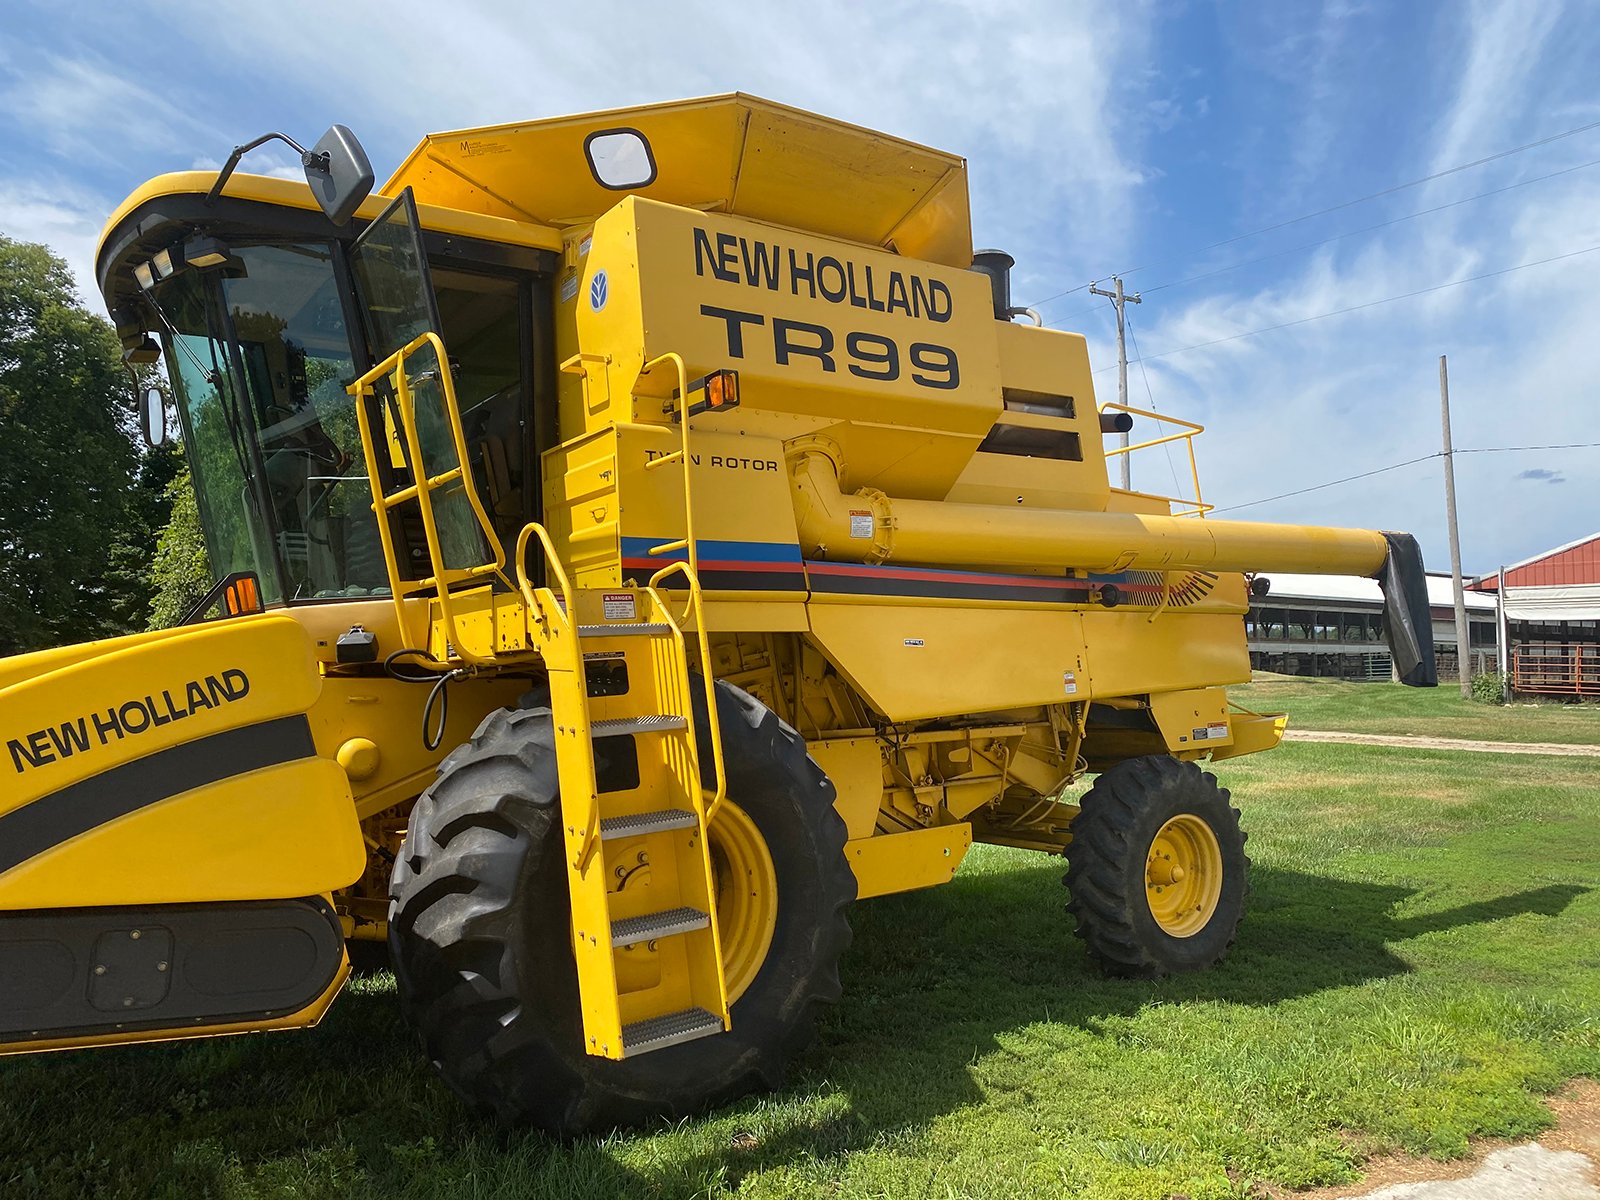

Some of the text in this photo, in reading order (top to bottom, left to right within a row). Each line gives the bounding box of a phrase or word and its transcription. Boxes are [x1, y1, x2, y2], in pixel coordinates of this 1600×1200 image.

[693, 227, 952, 323] NEW HOLLAND
[700, 304, 960, 389] TR99
[711, 456, 778, 472] ROTOR
[6, 668, 250, 773] NEW HOLLAND
